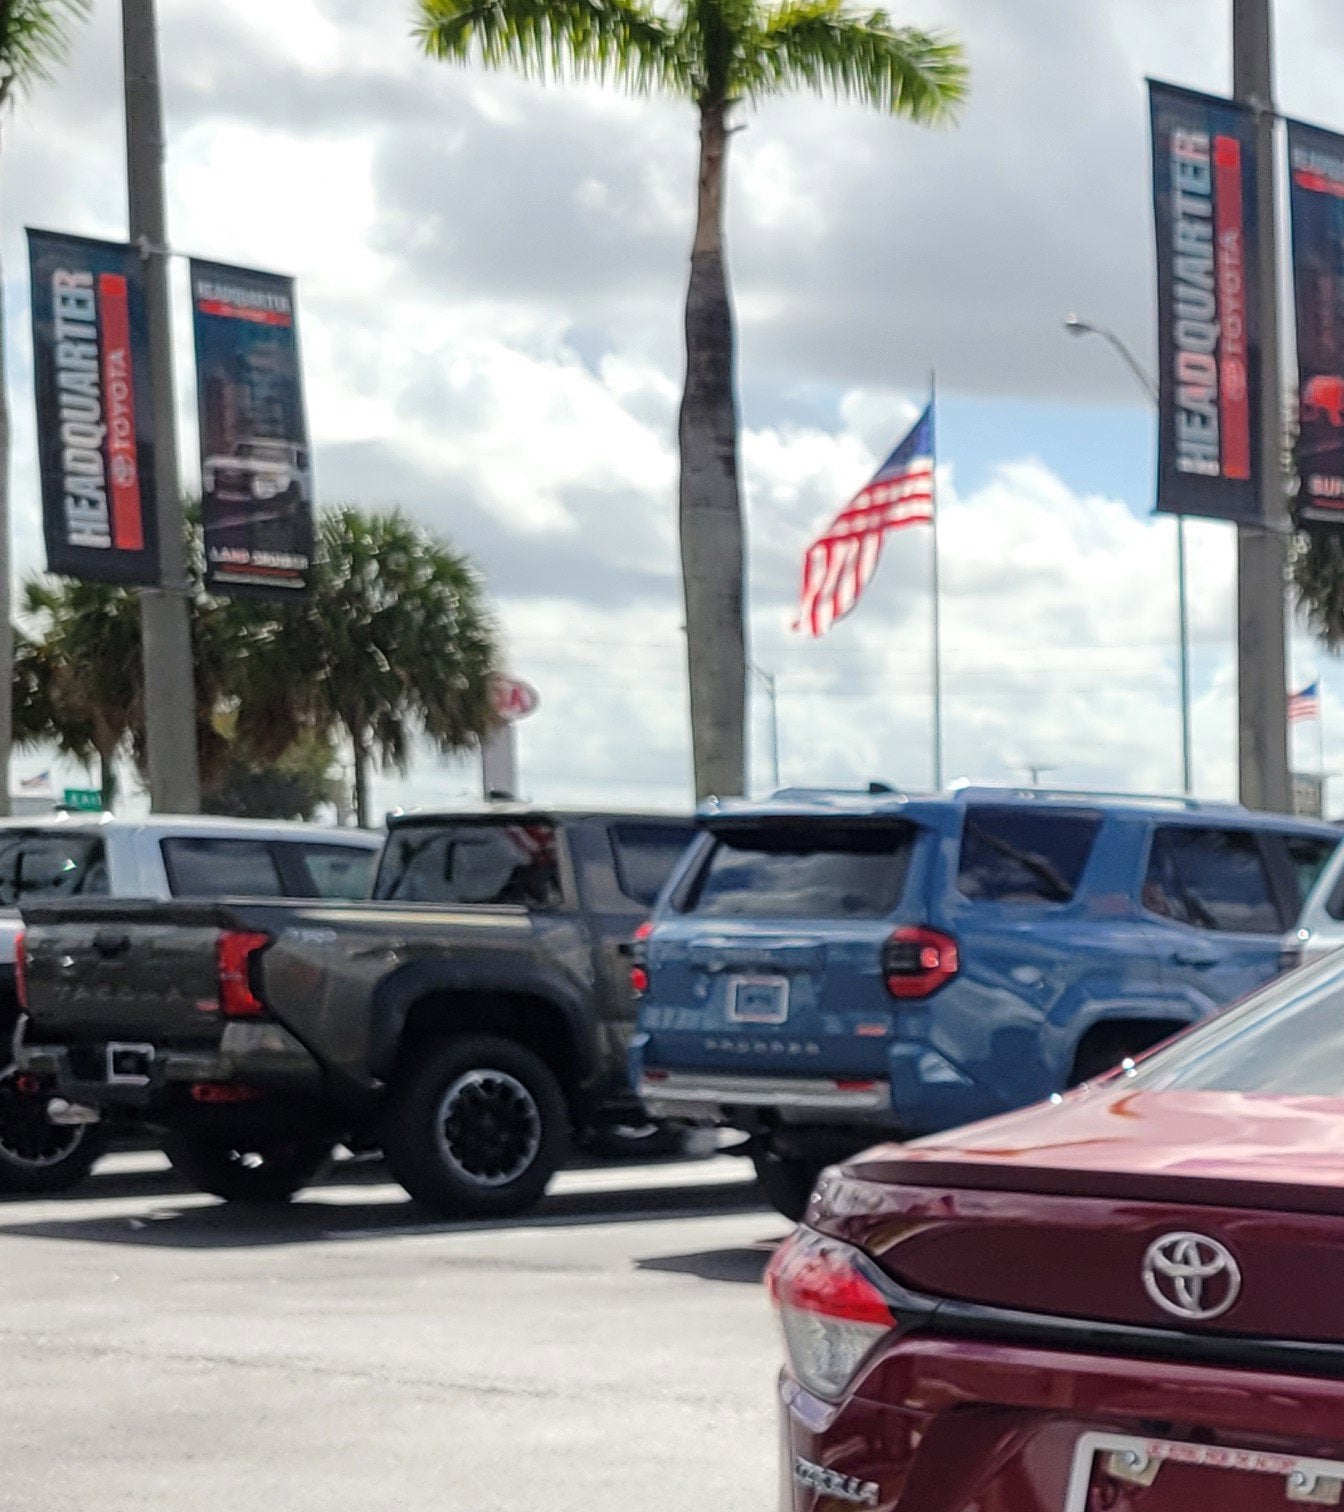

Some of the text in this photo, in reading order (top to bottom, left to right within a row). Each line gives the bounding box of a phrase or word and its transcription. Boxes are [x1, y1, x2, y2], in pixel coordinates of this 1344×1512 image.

[1172, 130, 1220, 476] HEADQUARTER
[1217, 228, 1244, 354] TOYOTA
[52, 267, 111, 549] HEADQUARTER
[106, 350, 134, 449] TOYOTA
